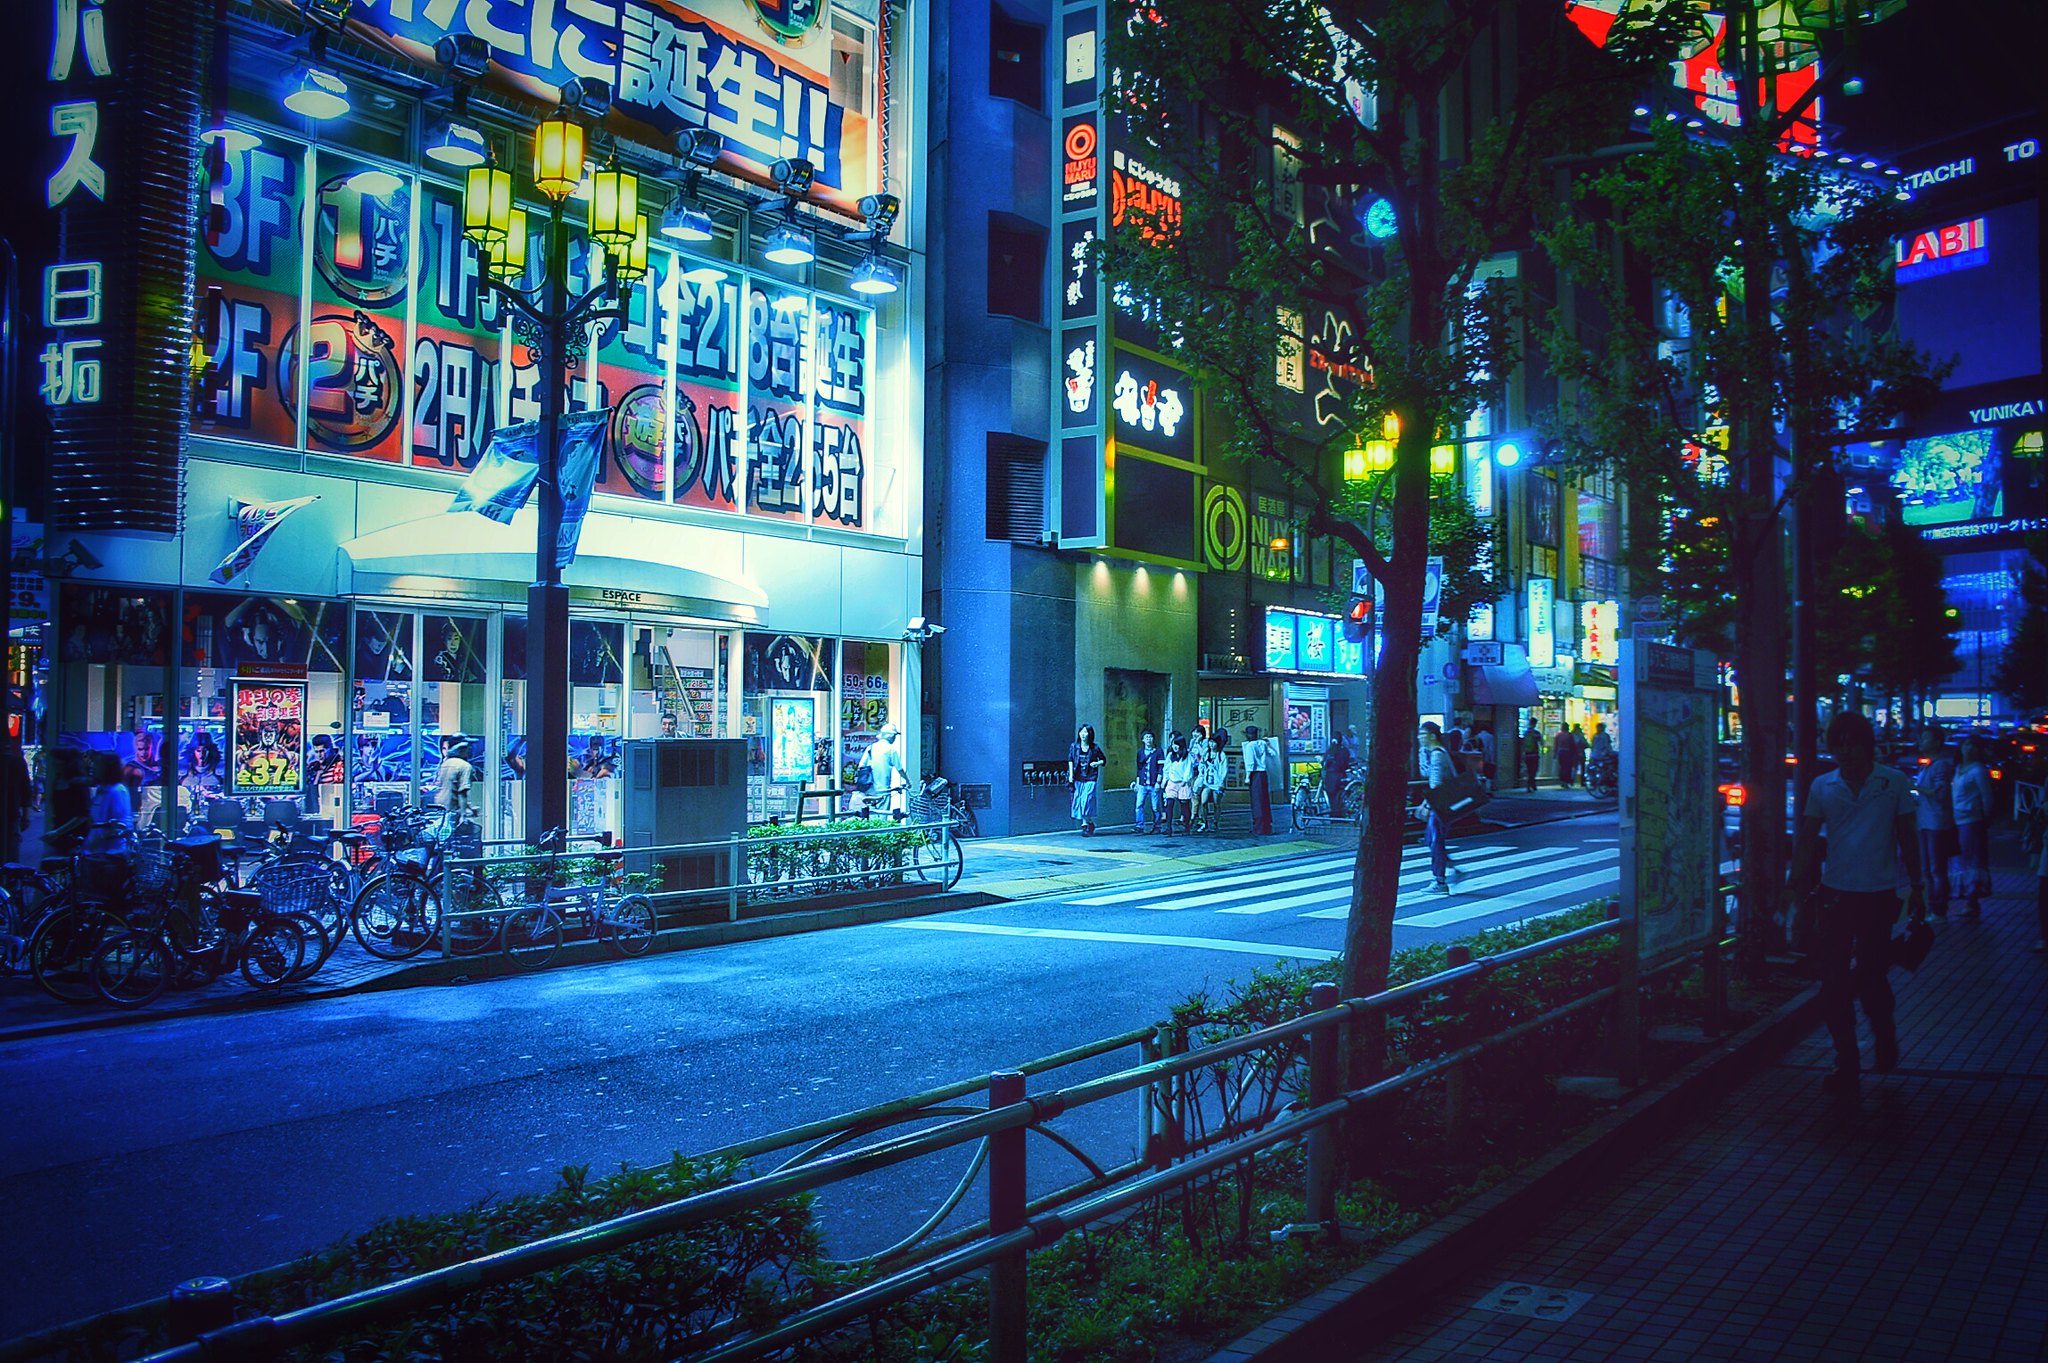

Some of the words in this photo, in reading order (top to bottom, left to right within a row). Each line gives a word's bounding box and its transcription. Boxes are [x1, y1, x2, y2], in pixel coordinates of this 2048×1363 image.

[1065, 167, 1097, 185] MARU
[1969, 401, 2035, 424] YUNIKA
[602, 589, 641, 602] ESPACE
[238, 687, 301, 707] 北斗の拳
[236, 757, 299, 786] 全37台
